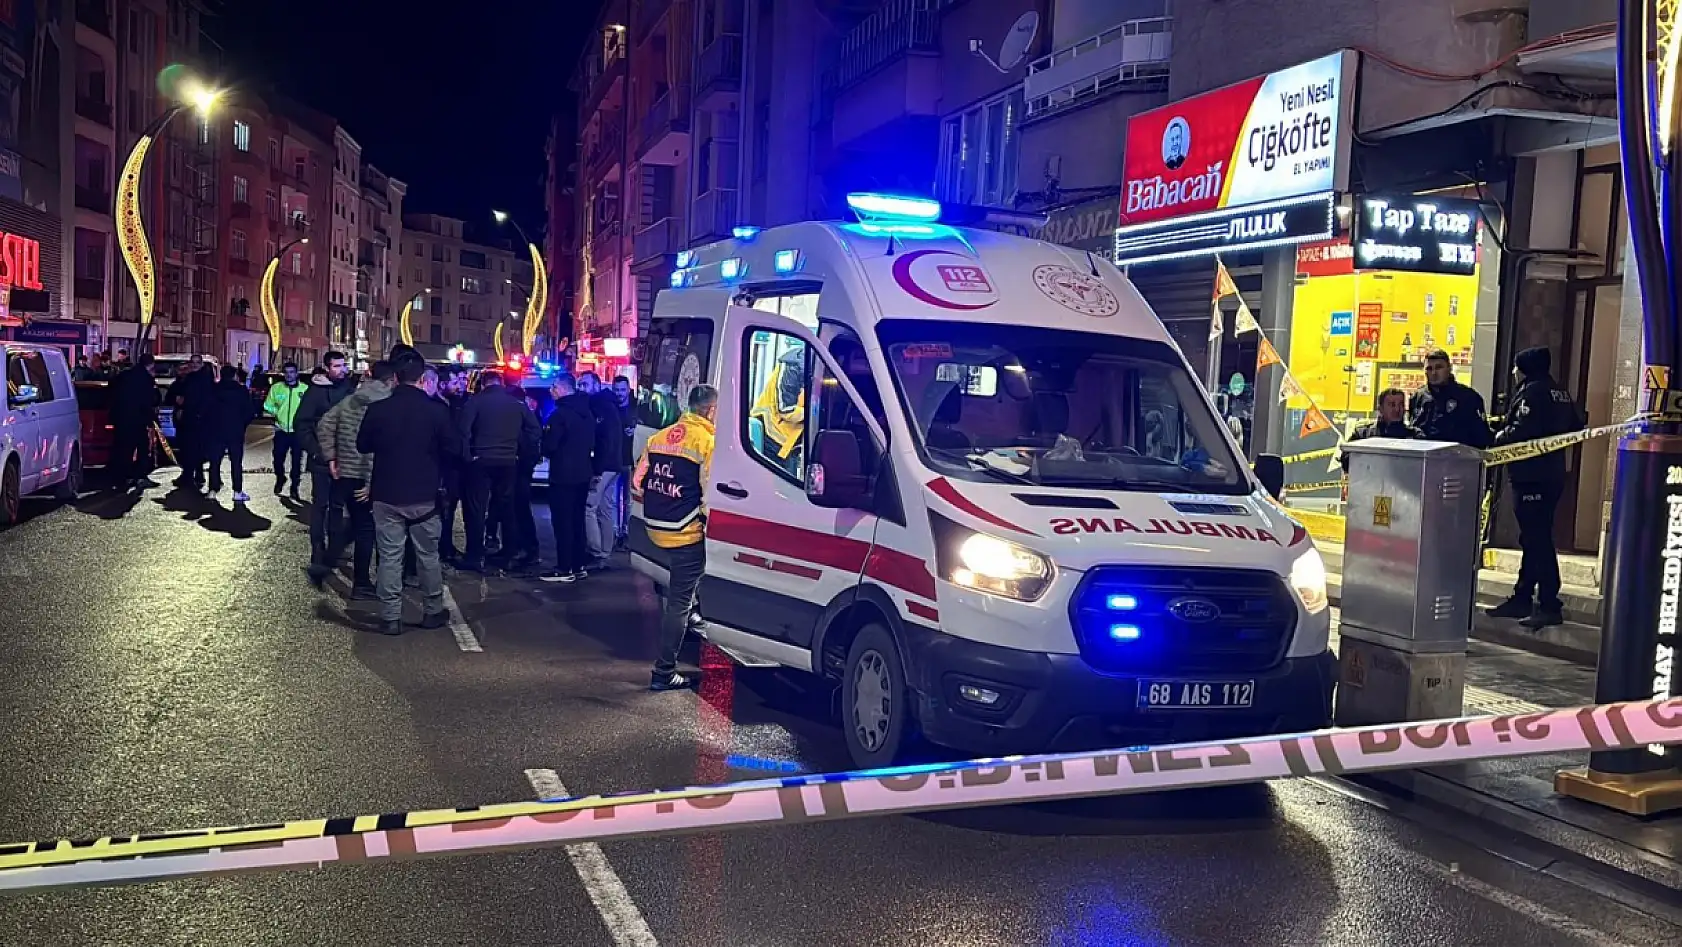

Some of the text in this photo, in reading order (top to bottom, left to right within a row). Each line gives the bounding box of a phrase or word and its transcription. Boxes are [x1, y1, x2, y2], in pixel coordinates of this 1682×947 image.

[1280, 77, 1335, 113] Yeni Nesil
[1248, 112, 1331, 172] Çiğköfte
[1366, 200, 1414, 234] Tap
[944, 268, 981, 281] 112
[1149, 683, 1171, 705] 68
[1180, 683, 1212, 705] AAS
[1223, 684, 1251, 705] 112
